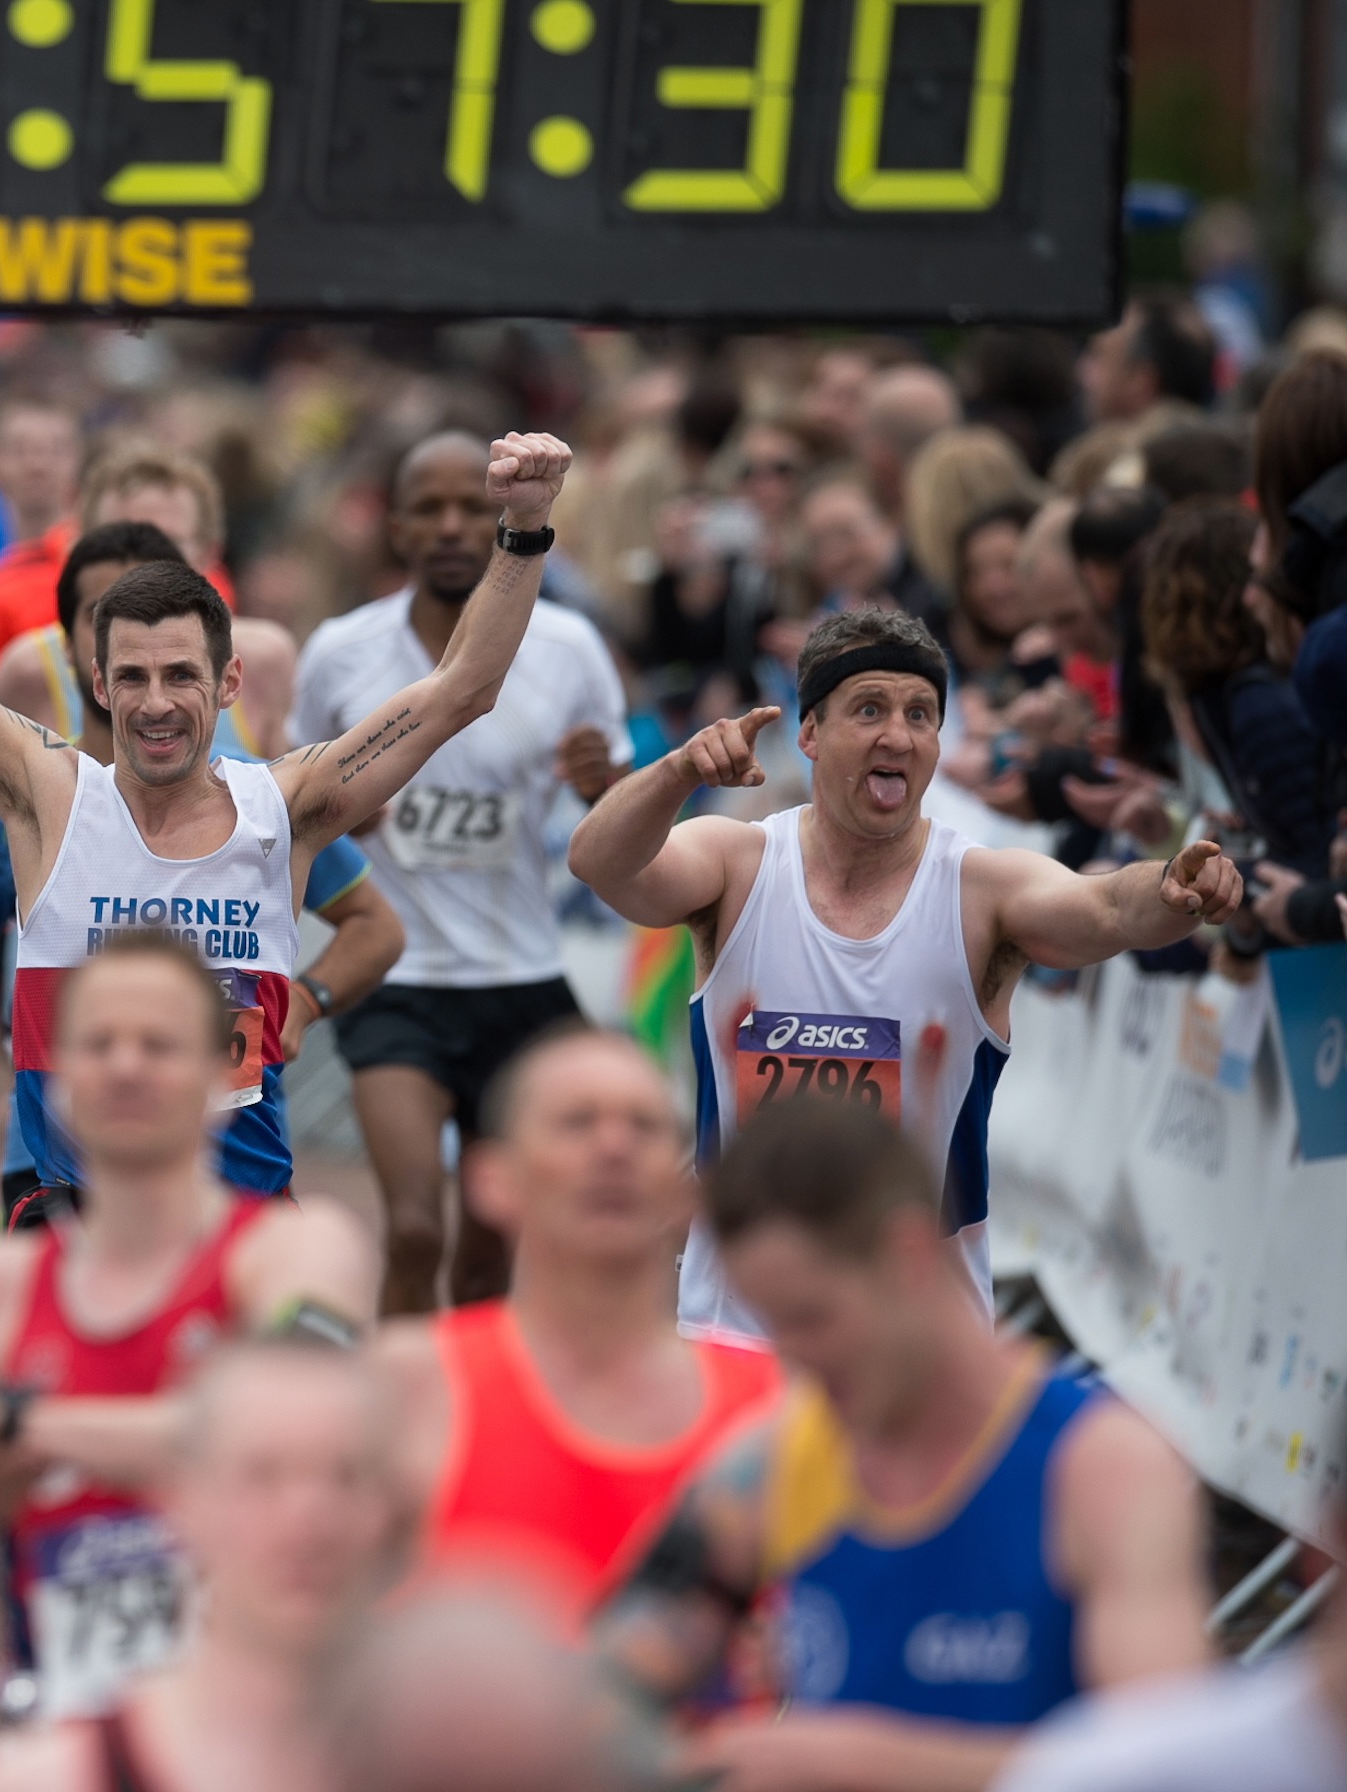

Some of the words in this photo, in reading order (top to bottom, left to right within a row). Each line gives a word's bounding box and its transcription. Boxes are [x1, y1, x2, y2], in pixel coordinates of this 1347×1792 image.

[396, 785, 502, 842] 6723
[89, 896, 260, 928] THORNEY
[86, 928, 198, 957] RUNG
[205, 929, 260, 959] CLUB
[797, 1024, 868, 1050] asics
[756, 1055, 882, 1114] 2796
